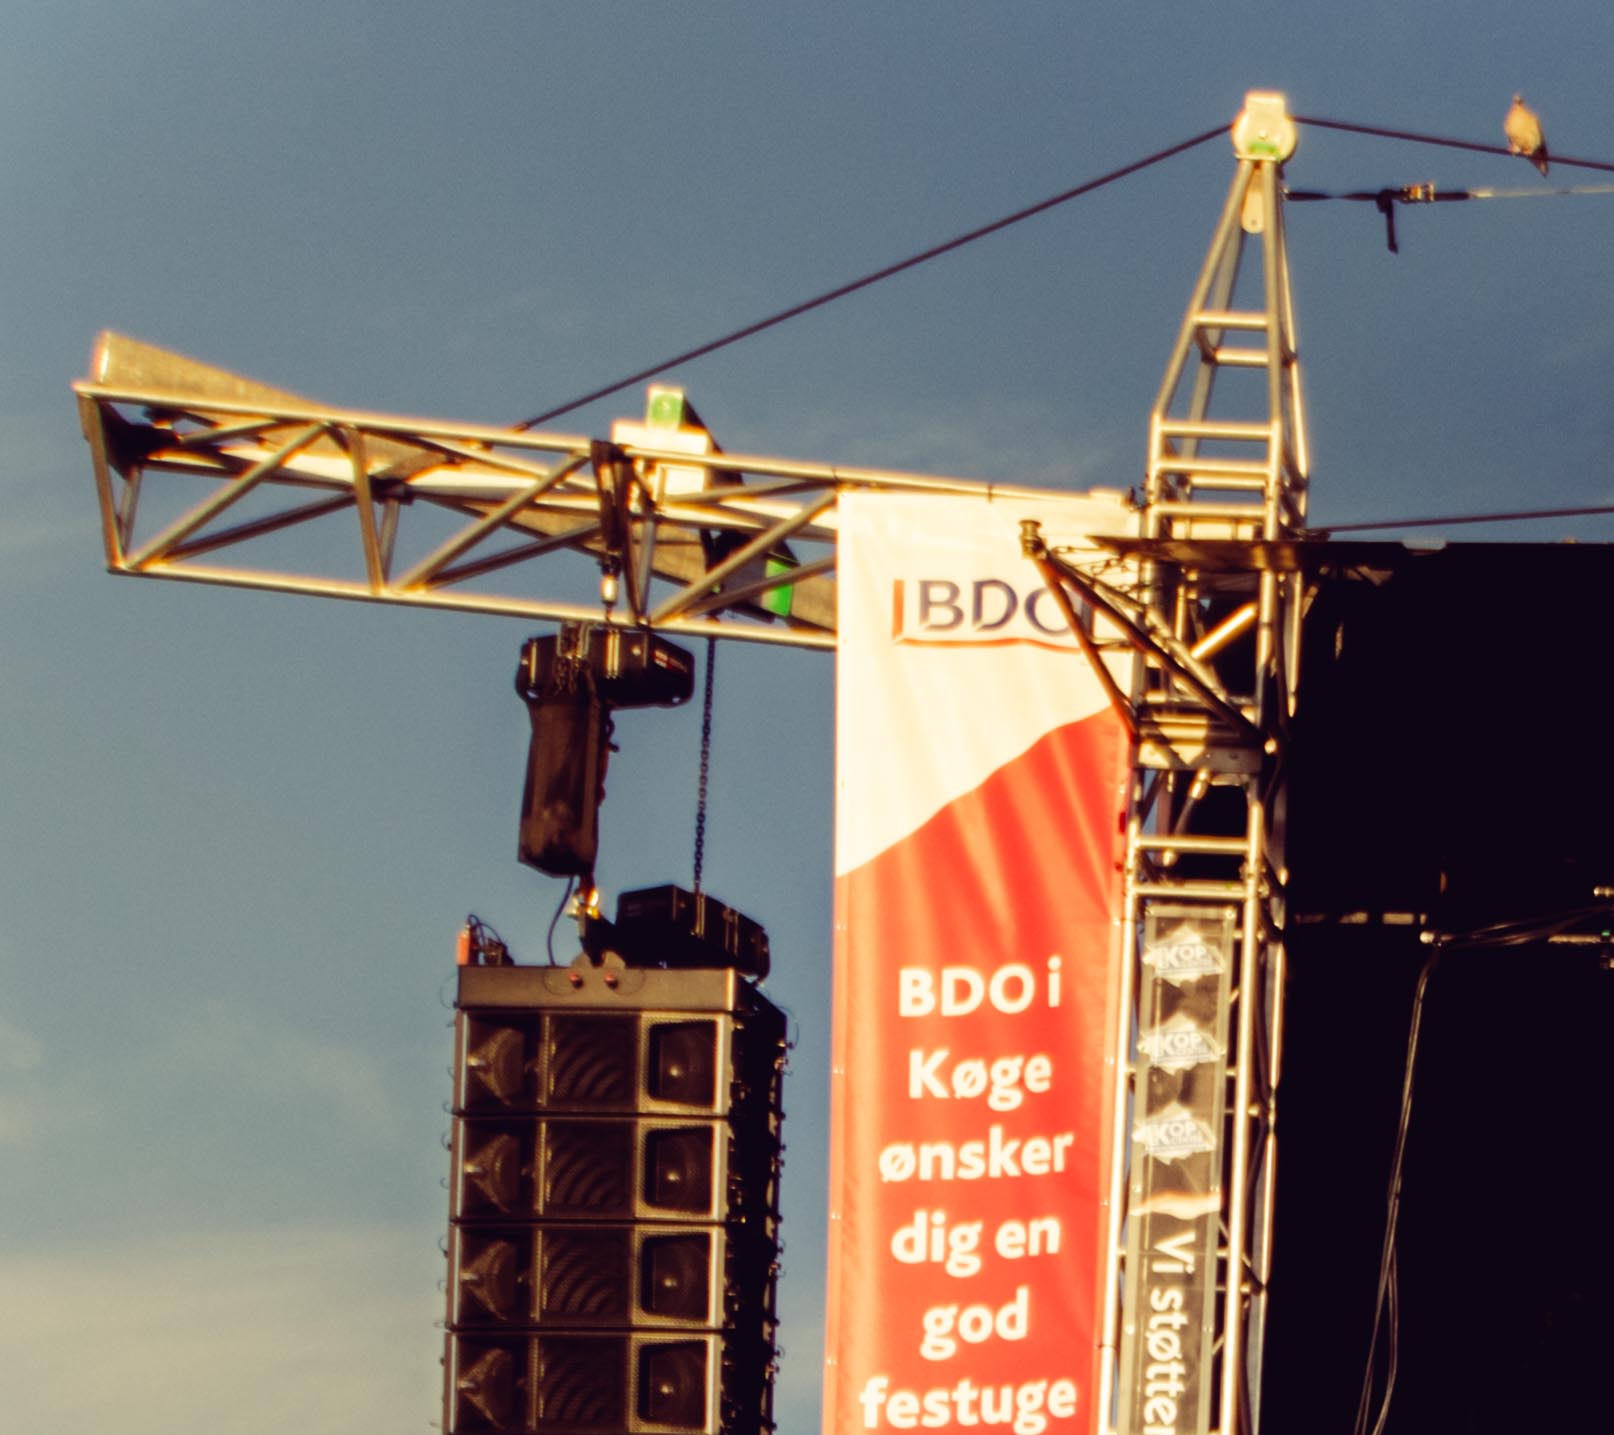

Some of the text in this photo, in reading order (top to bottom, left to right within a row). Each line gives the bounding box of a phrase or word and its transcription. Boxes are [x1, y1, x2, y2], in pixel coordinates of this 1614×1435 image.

[898, 956, 1062, 1018] BDO i
[908, 1048, 1053, 1112] Køge
[877, 1127, 1075, 1184] ønsker
[890, 1209, 1062, 1278] dig en
[1151, 1231, 1197, 1275] Vi
[920, 1286, 1030, 1362] god
